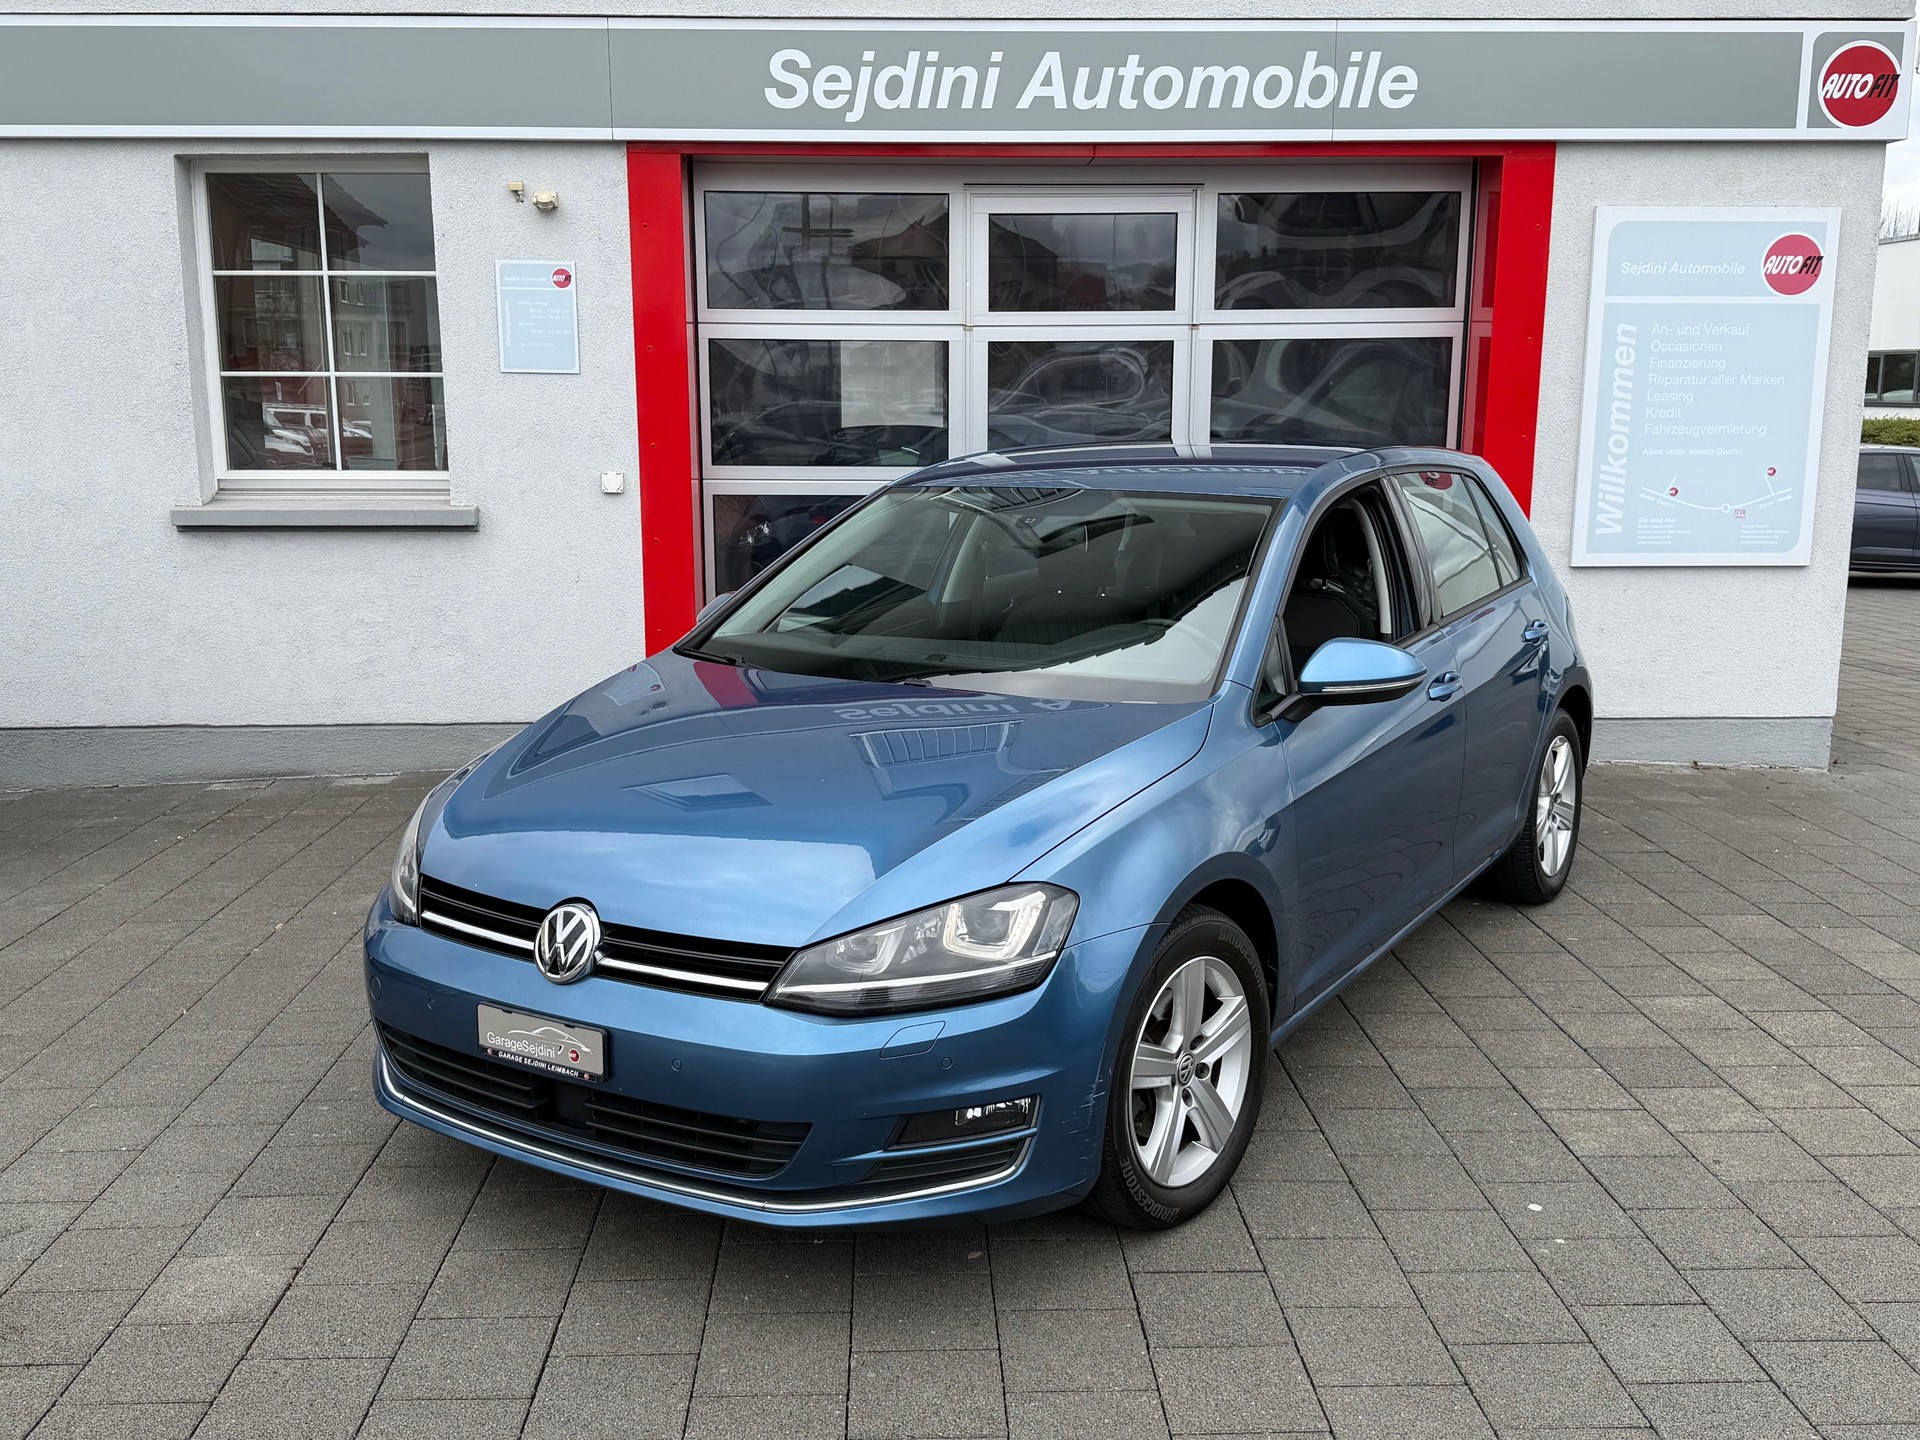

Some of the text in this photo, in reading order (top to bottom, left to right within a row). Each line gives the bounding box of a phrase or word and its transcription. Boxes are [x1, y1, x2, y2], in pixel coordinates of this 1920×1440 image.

[764, 48, 1419, 123] Sejdini Automobile
[1822, 72, 1901, 99] AUTOFIT
[1620, 261, 1746, 276] Sejdini Automobile
[1763, 254, 1824, 275] AUTOFIT
[1651, 323, 1751, 335] An- und Verkauf
[1650, 340, 1722, 352] Occasionen
[1648, 356, 1727, 372] Finanzierung
[1648, 373, 1786, 388] Reparatur aller Marken
[1646, 390, 1694, 405] Leasing
[1645, 406, 1682, 418] Kredit
[1595, 322, 1638, 535] Willkommen
[1644, 423, 1768, 438] Fahrzeugvermietung
[486, 1031, 556, 1059] GarageSejdini
[498, 1051, 579, 1077] GARAGE SEJDINI LEIMBACH
[1120, 1156, 1181, 1222] BRIDGESTONE
